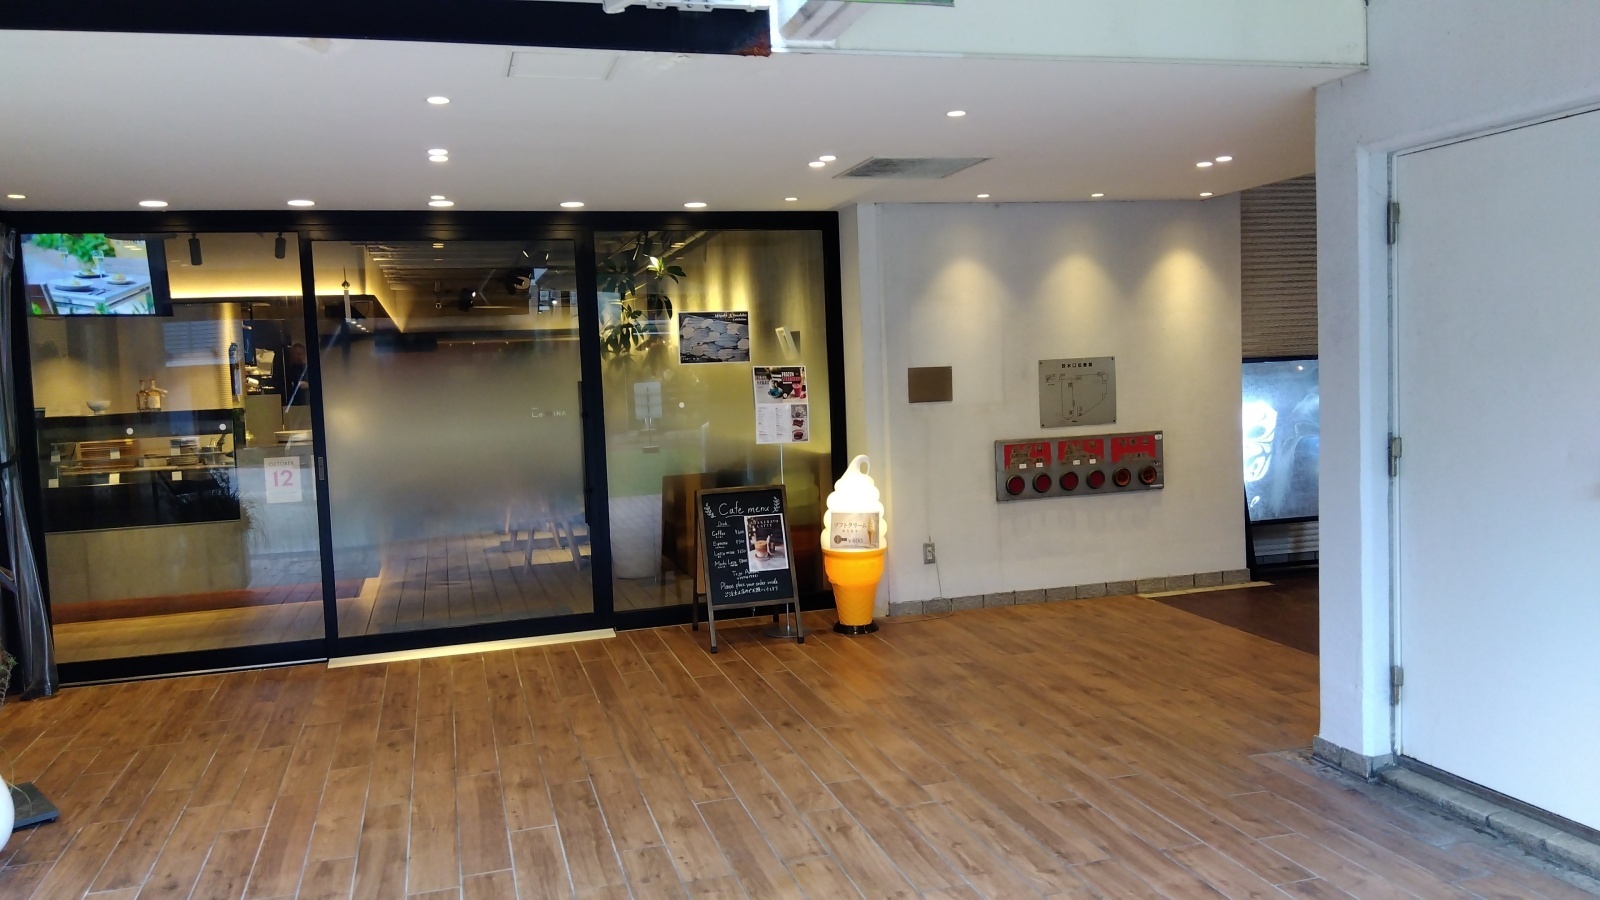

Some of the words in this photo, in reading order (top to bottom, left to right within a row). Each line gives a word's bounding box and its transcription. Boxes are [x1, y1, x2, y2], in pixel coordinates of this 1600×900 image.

[272, 469, 294, 487] 12
[718, 500, 744, 516] Cafe
[747, 505, 770, 514] menu
